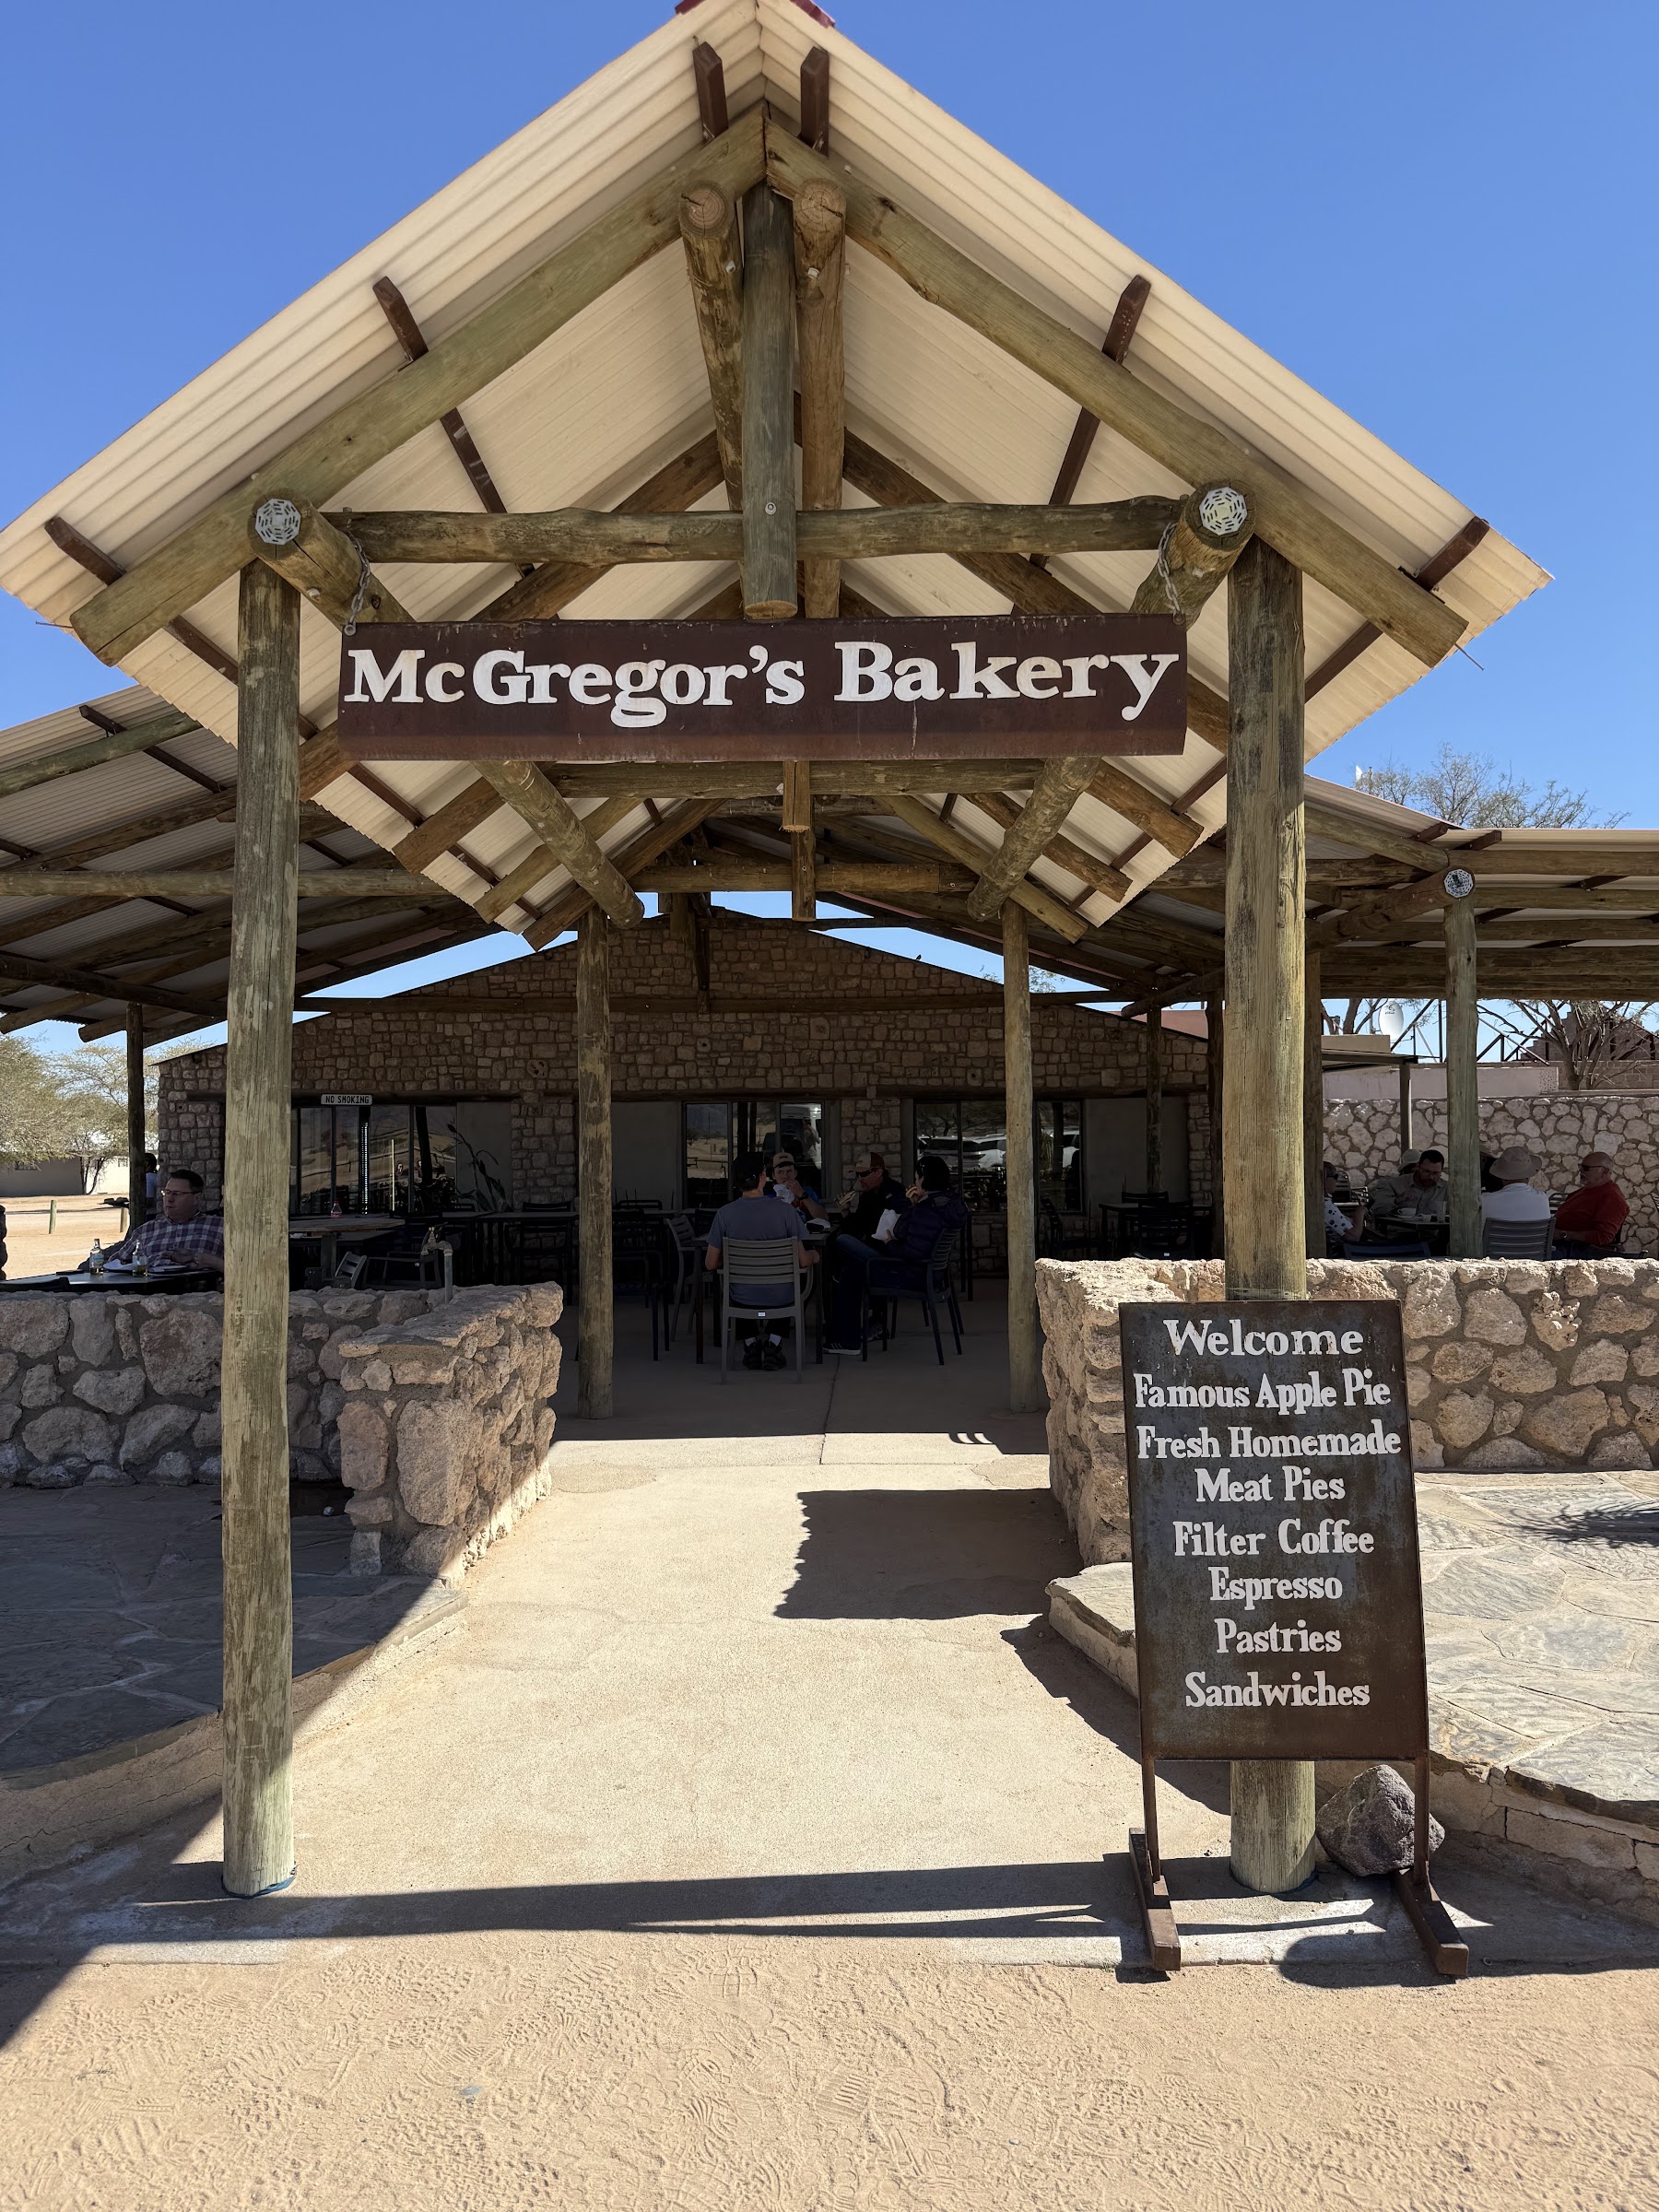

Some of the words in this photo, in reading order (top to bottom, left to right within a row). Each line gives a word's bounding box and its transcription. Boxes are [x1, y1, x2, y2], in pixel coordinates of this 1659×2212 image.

[345, 644, 806, 728] McGregor's
[834, 641, 1180, 721] Bakery
[325, 1095, 335, 1104] NO
[337, 1095, 370, 1104] SMOKING
[1163, 1319, 1364, 1357] Welcome
[1134, 1373, 1250, 1408] Famous
[1255, 1371, 1336, 1416] Apple
[1343, 1368, 1392, 1406] Pie
[1136, 1425, 1221, 1459] Fresh
[1228, 1419, 1402, 1458] Homemade
[1194, 1468, 1274, 1502] Meat
[1282, 1465, 1346, 1500] Pies
[1172, 1521, 1266, 1557] Filter
[1278, 1518, 1375, 1555] Coffee
[1208, 1567, 1343, 1610] Espresso
[1214, 1618, 1342, 1653] Pastries
[1185, 1671, 1371, 1708] Sandwiches
